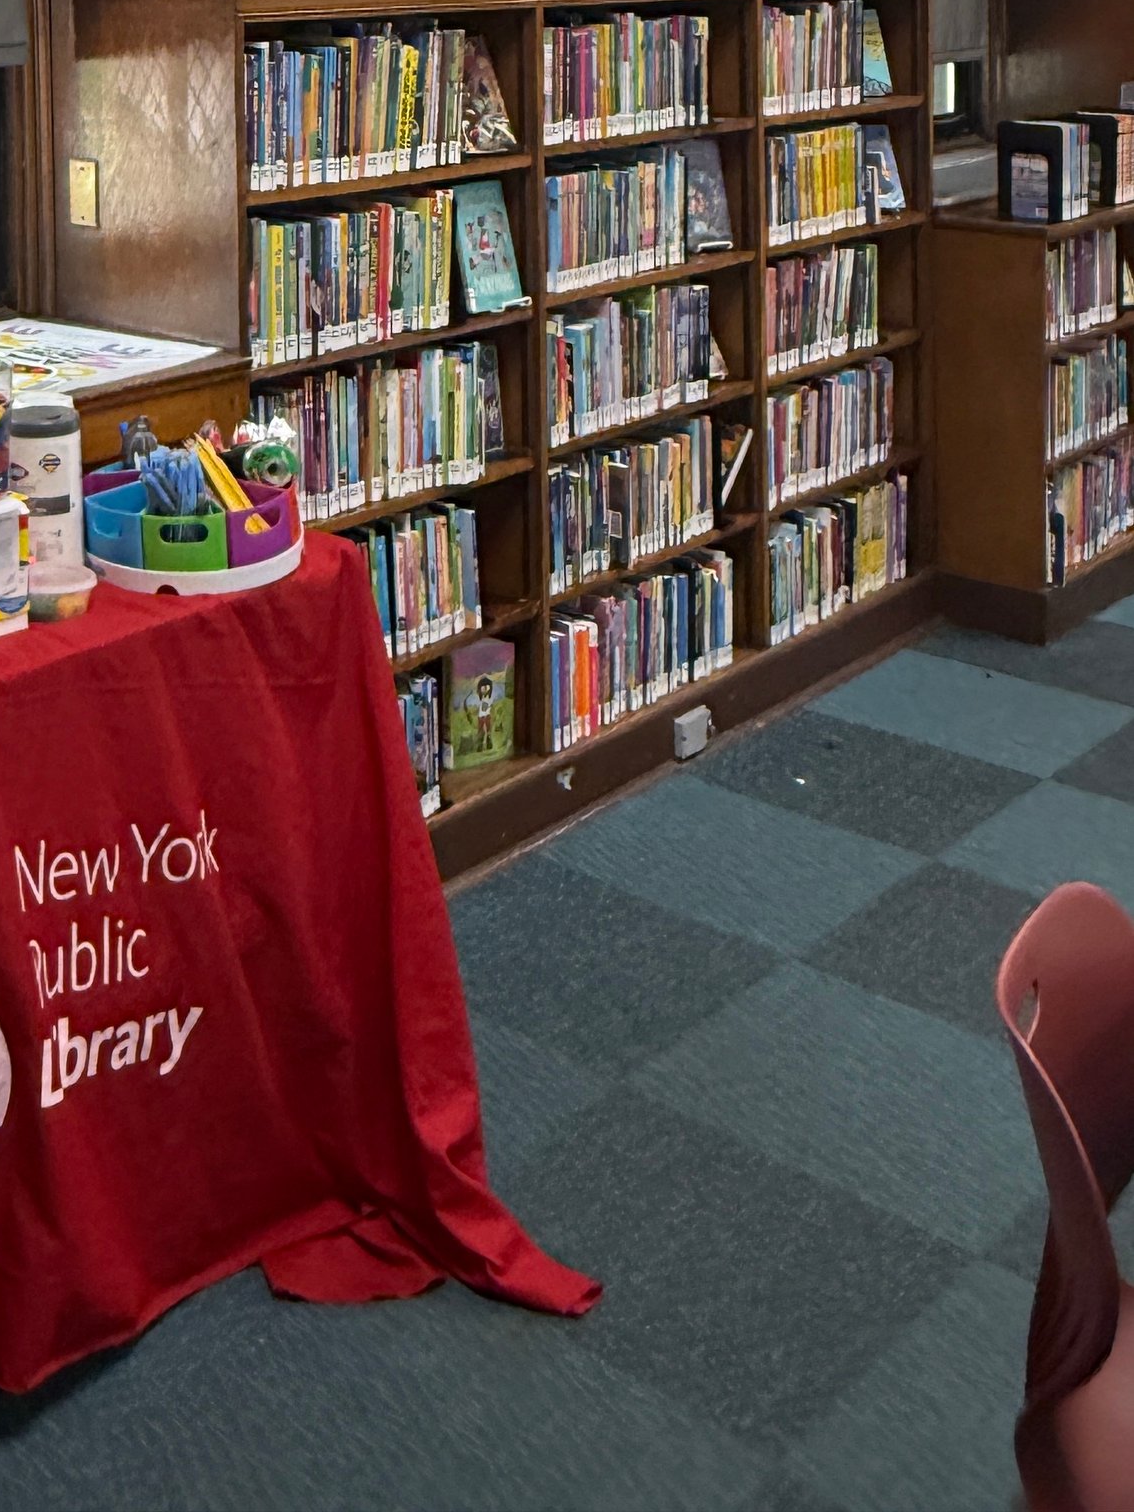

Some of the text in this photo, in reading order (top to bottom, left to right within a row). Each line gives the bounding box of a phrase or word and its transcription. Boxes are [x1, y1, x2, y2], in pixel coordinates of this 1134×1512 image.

[14, 809, 220, 913] New York
[41, 1007, 204, 1108] Lbrary
